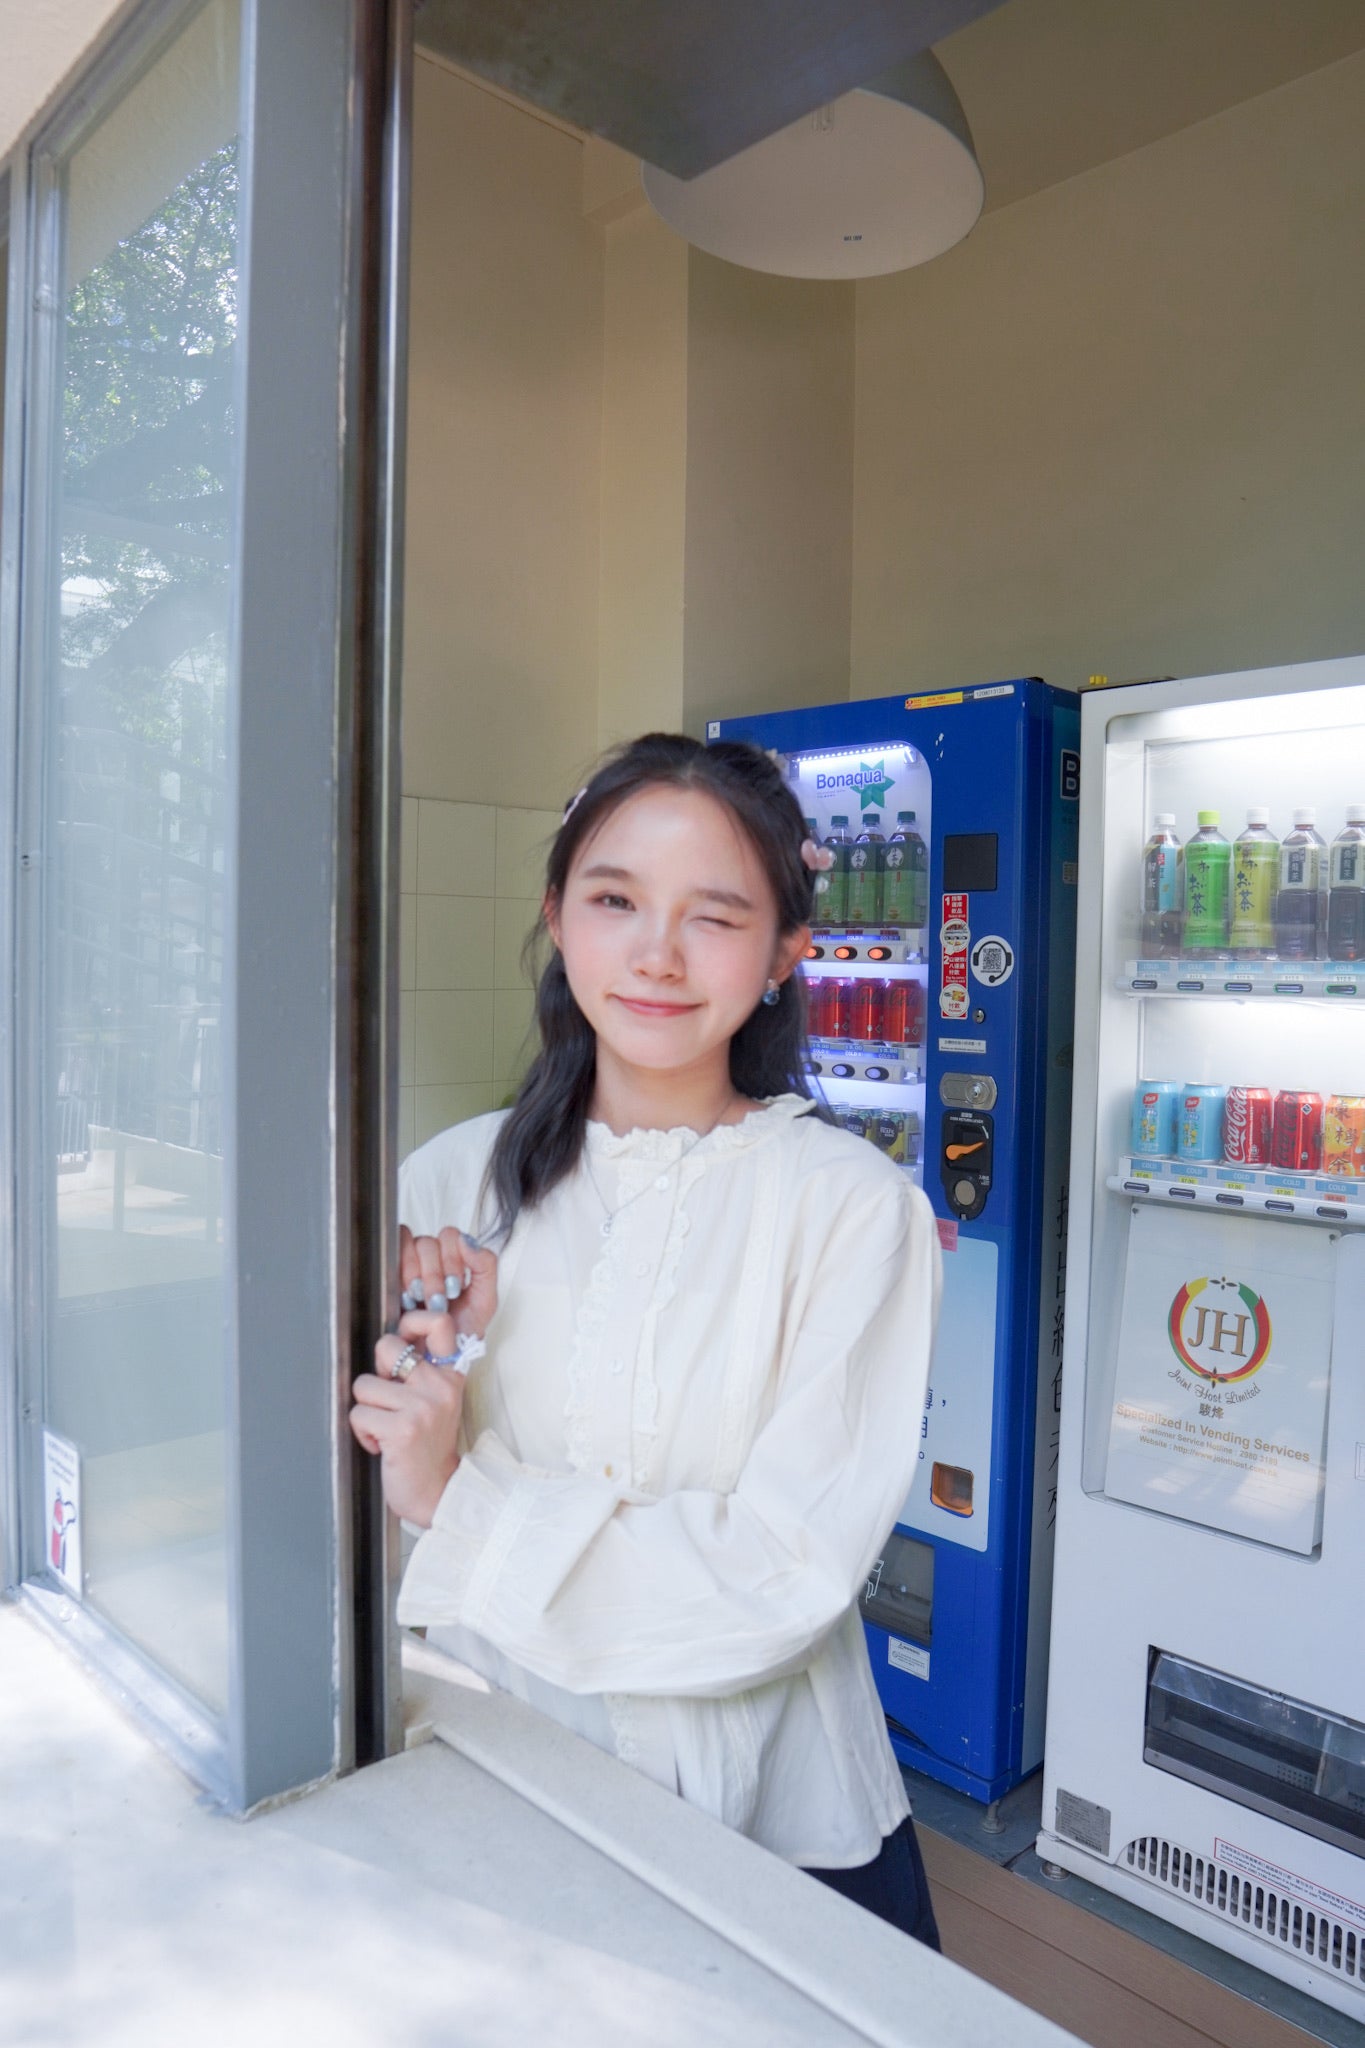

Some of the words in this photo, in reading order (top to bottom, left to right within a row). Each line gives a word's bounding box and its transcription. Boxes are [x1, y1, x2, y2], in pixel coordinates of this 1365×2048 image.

[817, 770, 882, 789] Bonaqua
[944, 896, 951, 907] 1
[943, 955, 950, 965] 2
[1224, 1088, 1247, 1164] Coca-Cola
[1186, 1167, 1203, 1175] COLD
[1233, 1172, 1250, 1180] COLD
[1282, 1178, 1300, 1187] COLD
[1328, 1183, 1346, 1192] COLD
[1187, 1306, 1251, 1357] JH
[1168, 1369, 1192, 1391] Joint
[1194, 1384, 1221, 1403] Host
[1225, 1382, 1261, 1404] Limited
[1116, 1403, 1182, 1430] Specialized
[1200, 1424, 1250, 1449] Vending
[1254, 1438, 1310, 1462] Services
[1141, 1425, 1175, 1439] Customer
[1177, 1433, 1205, 1447] Service
[1207, 1441, 1232, 1454] Hotline
[1139, 1434, 1168, 1448] Website
